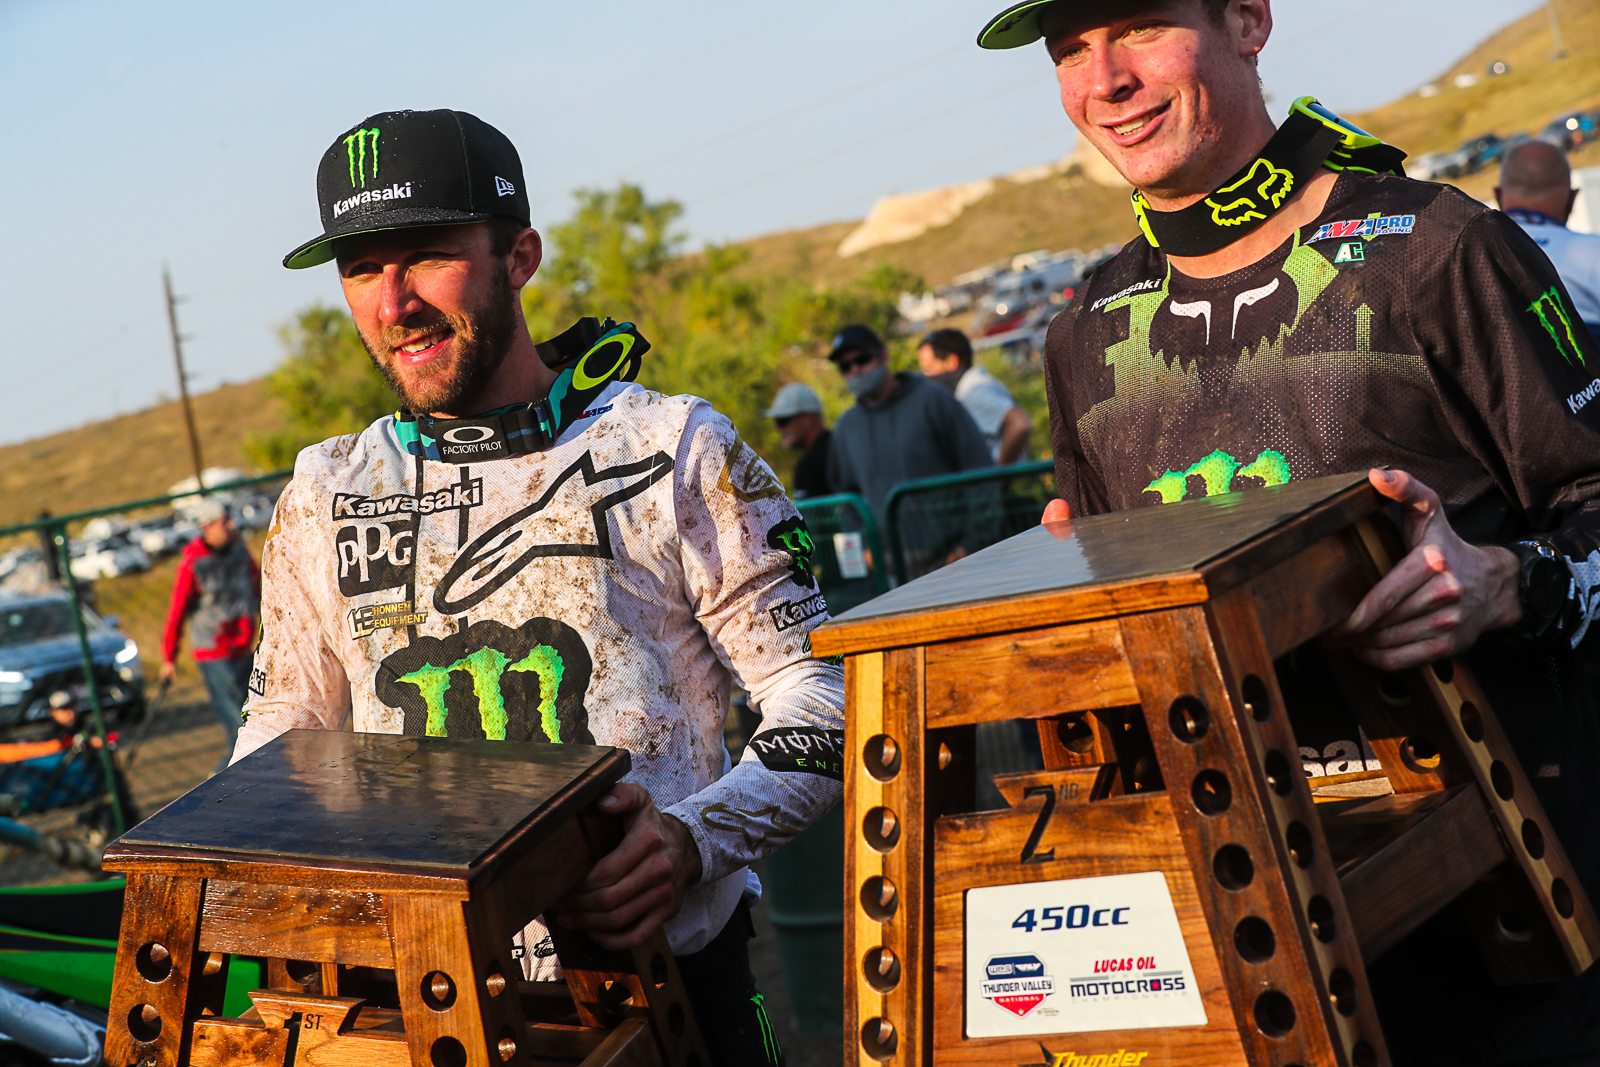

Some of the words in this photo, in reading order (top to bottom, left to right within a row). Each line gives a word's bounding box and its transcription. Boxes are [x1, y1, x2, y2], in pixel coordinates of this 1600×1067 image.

[333, 182, 412, 218] Kawasaki
[1303, 219, 1375, 245] AMA
[1375, 215, 1415, 229] PRO
[1090, 279, 1161, 312] Kawasaki
[442, 444, 479, 455] FACTORY
[480, 441, 502, 452] PILOT
[334, 481, 481, 518] Kawasaki
[374, 613, 427, 628] EQUIPMENT
[1012, 904, 1130, 933] 450cc
[1093, 957, 1133, 973] LUCAS
[1136, 956, 1156, 970] OIL
[983, 982, 1020, 994] THUNDER
[1021, 980, 1052, 991] VALLEY
[1070, 977, 1186, 997] MOTOCROSS
[1051, 1048, 1149, 1067] Thunder
